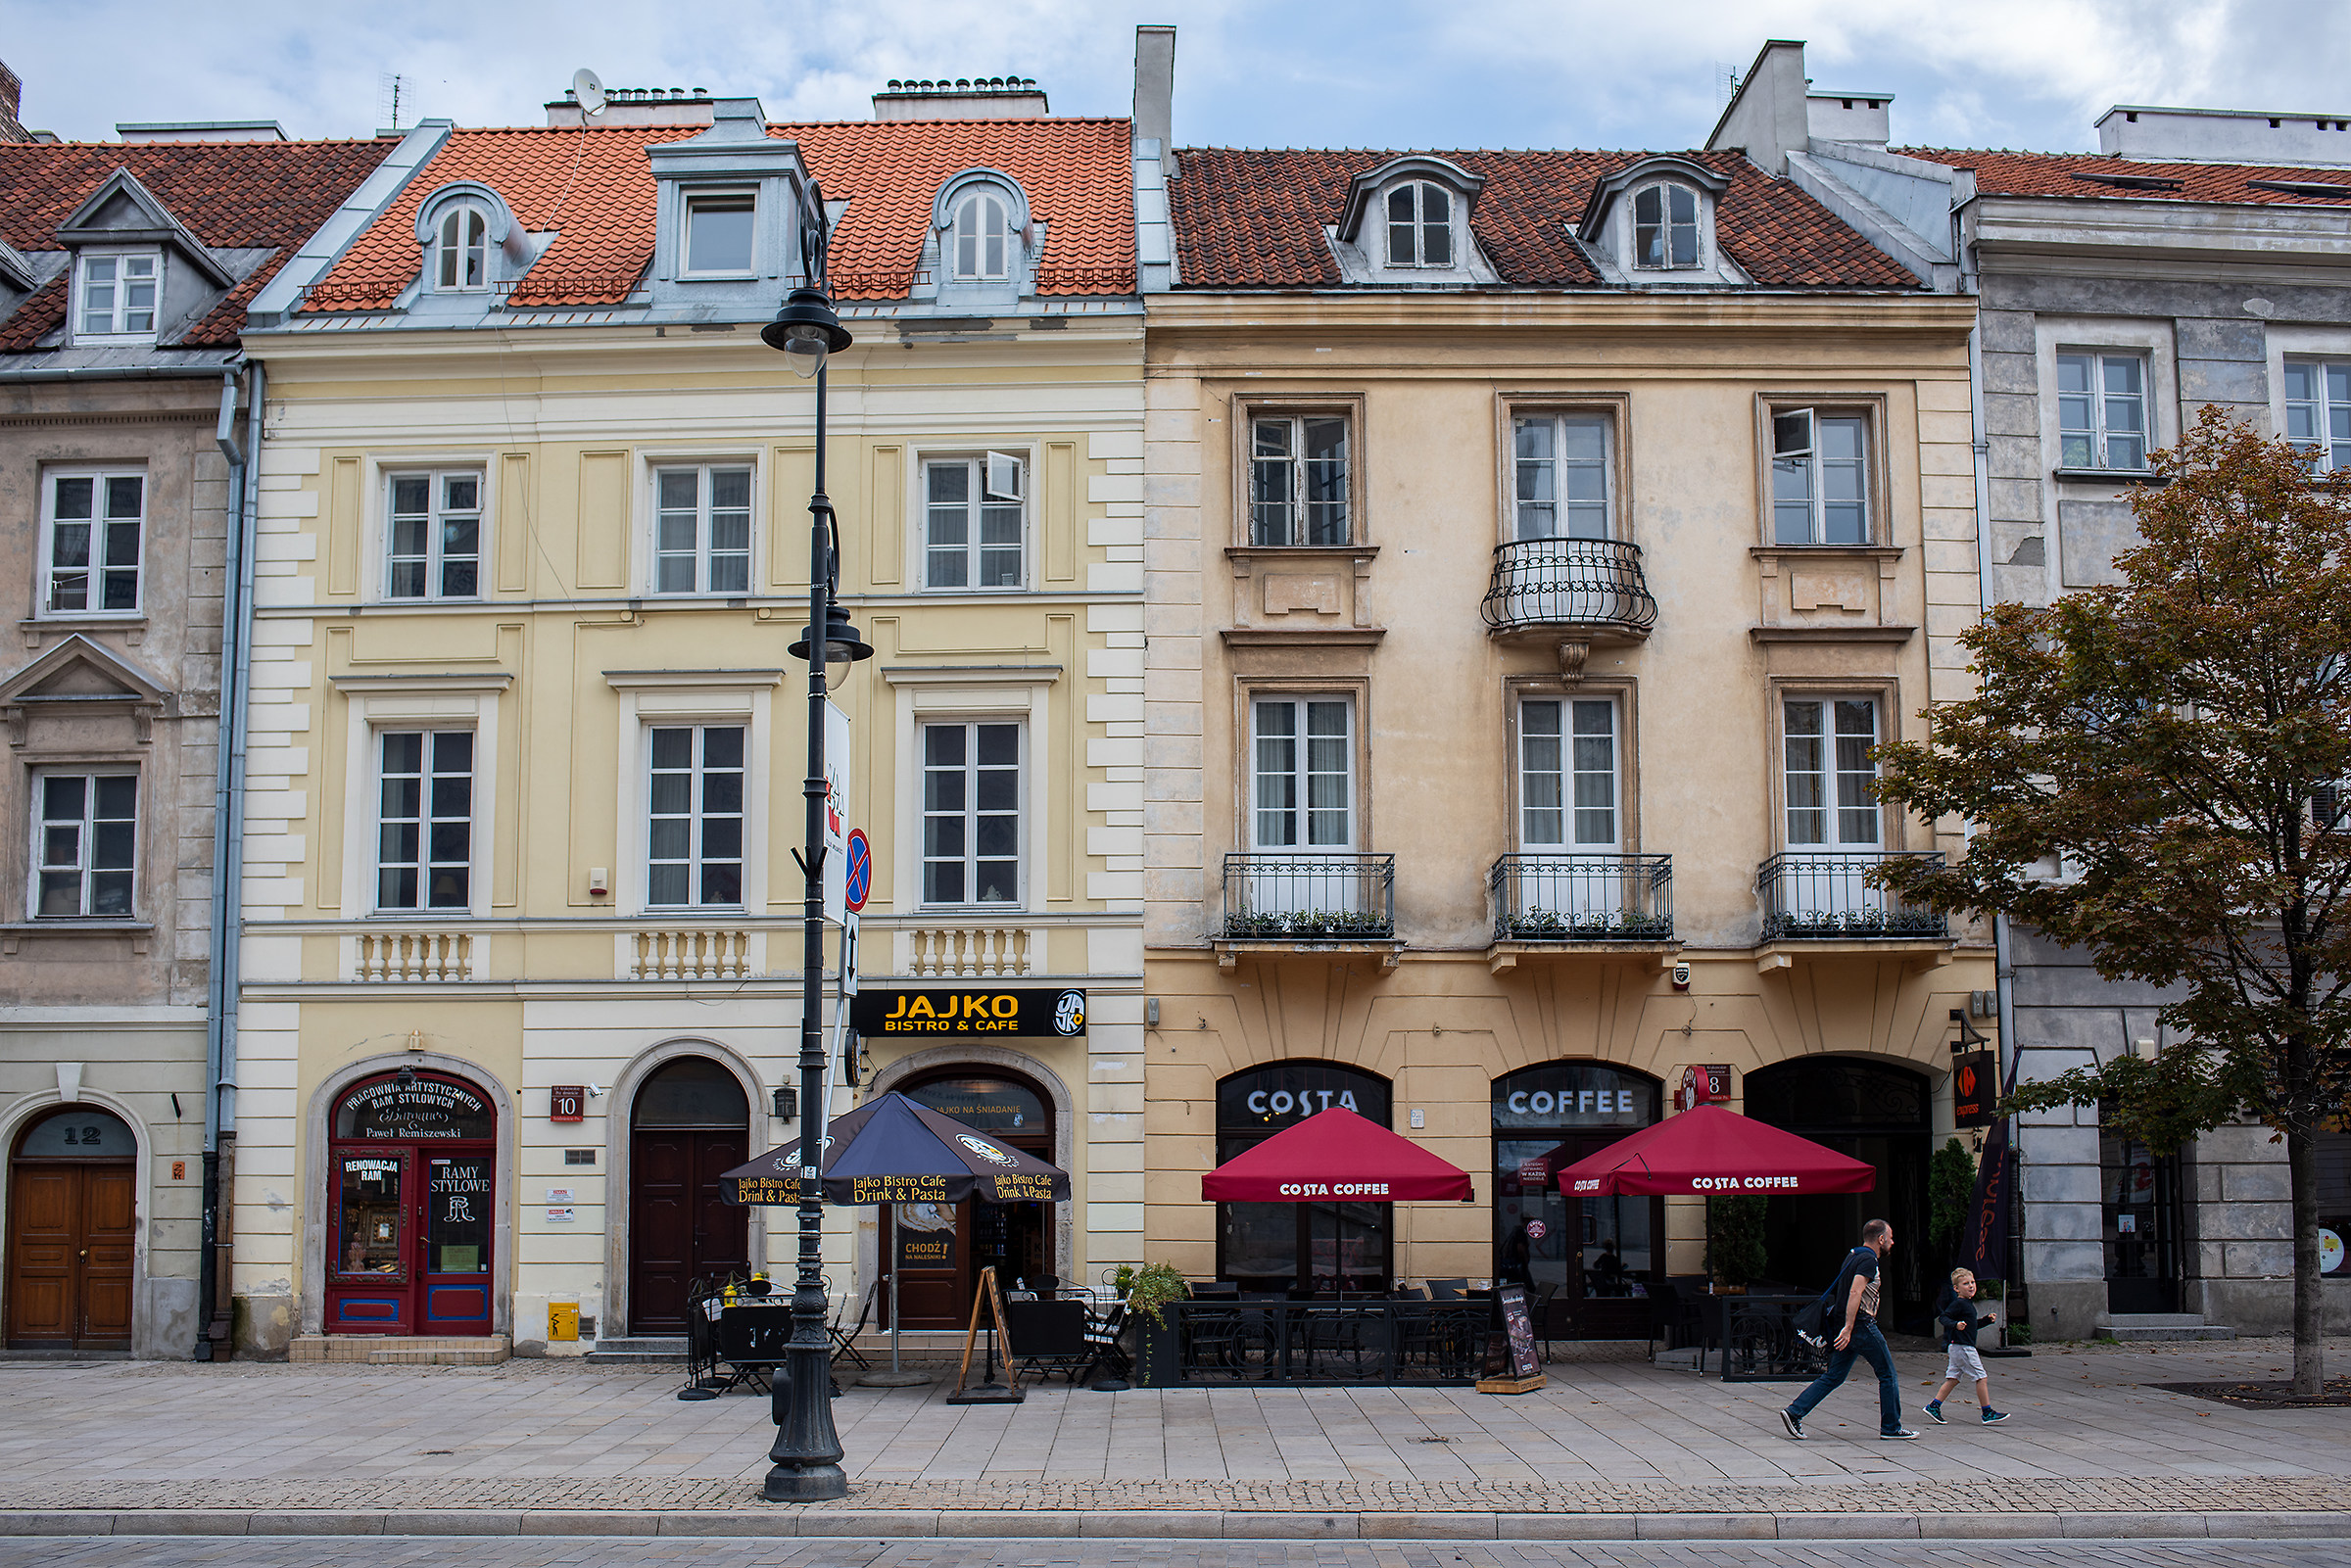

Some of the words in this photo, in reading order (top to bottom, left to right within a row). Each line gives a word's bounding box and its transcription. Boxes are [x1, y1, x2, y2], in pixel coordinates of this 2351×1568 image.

[885, 994, 1019, 1019] JAJKO
[885, 1020, 950, 1031] BISTRO
[956, 1020, 969, 1031] &
[975, 1020, 1019, 1030] CAFE
[1708, 1076, 1720, 1094] 8
[346, 1083, 401, 1111] PRACOWNIA
[405, 1081, 482, 1113] ARTYSTYCZNYCH
[371, 1094, 395, 1110] RAM
[398, 1093, 456, 1110] STYLOWYCH
[1246, 1089, 1360, 1117] COSTA
[1508, 1089, 1634, 1115] COFFEE
[557, 1097, 576, 1116] 10
[976, 1104, 1021, 1114] ŚNIADANIE
[1956, 1102, 1980, 1117] express
[64, 1126, 101, 1145] 12
[365, 1127, 394, 1138] Paweł
[399, 1127, 461, 1138] Remiszewski
[345, 1160, 399, 1172] RENOWACJA
[442, 1166, 479, 1179] RAMY
[360, 1170, 382, 1181] RAM
[994, 1174, 1011, 1187] Jajko
[1012, 1174, 1033, 1186] Bistro
[1034, 1174, 1052, 1186] Cafe
[430, 1179, 490, 1193] STYLOWE
[738, 1177, 758, 1192] Jajko
[760, 1177, 783, 1189] Bistro
[853, 1177, 881, 1191] Jajko
[884, 1175, 912, 1188] Bistro
[920, 1175, 946, 1187] Cafe
[1279, 1183, 1329, 1197] COSTA
[1333, 1183, 1390, 1196] COFFEE
[1692, 1176, 1740, 1190] COSTA
[1744, 1176, 1799, 1189] COFFEE
[738, 1189, 764, 1203] Drink
[766, 1189, 775, 1203] &
[853, 1188, 891, 1203] Drink
[895, 1188, 907, 1201] &
[911, 1187, 946, 1201] Pasta
[996, 1186, 1022, 1200] Drink
[1030, 1186, 1052, 1200] Pasta
